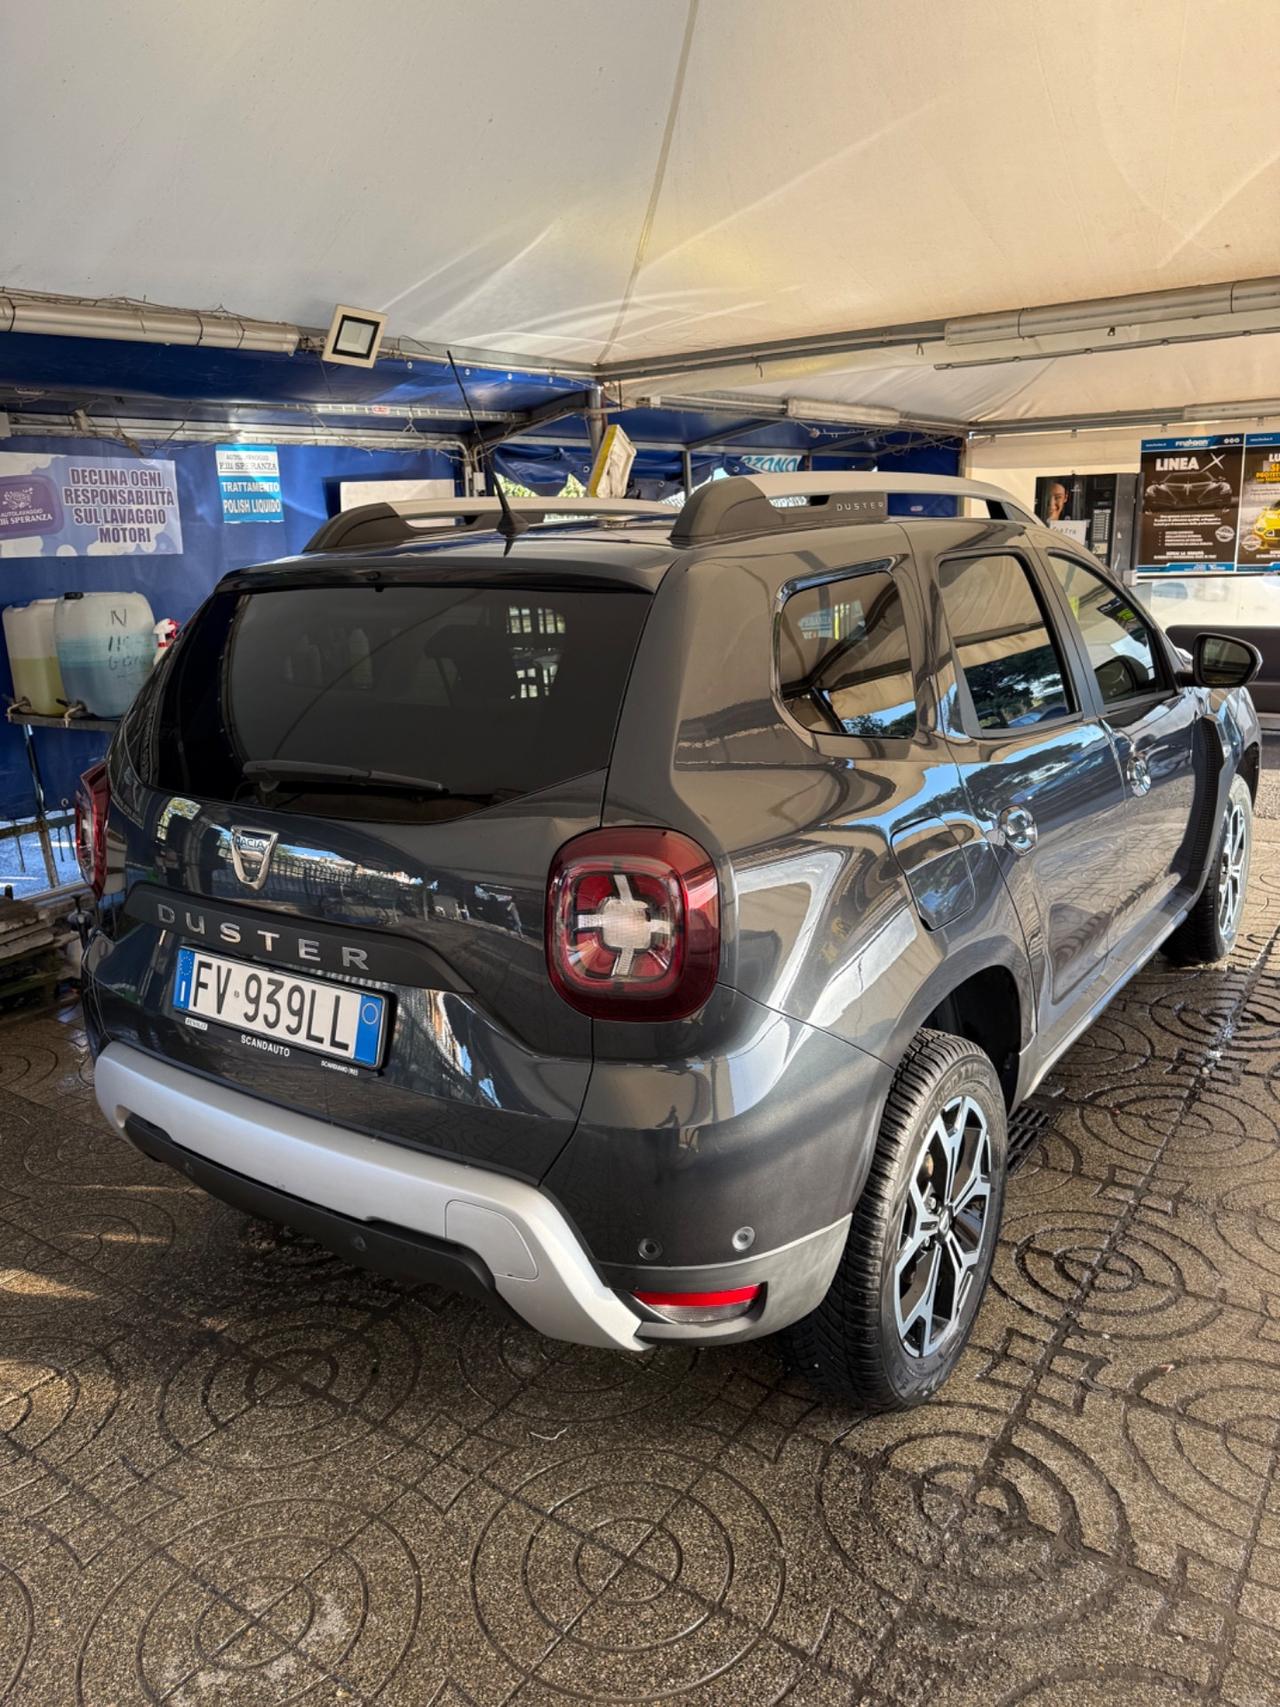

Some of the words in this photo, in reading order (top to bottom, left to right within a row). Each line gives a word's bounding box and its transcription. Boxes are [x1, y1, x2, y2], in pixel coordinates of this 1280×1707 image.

[1155, 457, 1200, 471] LINEA
[1199, 453, 1226, 473] X
[71, 468, 128, 486] DECLINA
[131, 470, 162, 487] OGNI
[222, 482, 280, 492] TRATTAMENTO
[64, 487, 174, 506] RESPONSABILITÀ
[224, 499, 250, 513] POLISH
[251, 499, 281, 513] LIQUIDO
[836, 501, 885, 511] DUSTER
[10, 513, 53, 525] SPERANZA
[74, 507, 101, 525] SUL
[102, 508, 167, 525] LAVAGGIO
[99, 527, 151, 543] MOTORI
[235, 835, 265, 850] DACIA
[157, 903, 370, 970] DUSTER
[193, 959, 232, 1015] FV
[243, 972, 350, 1051] 939LL
[240, 1034, 290, 1058] SCANDAUTO
